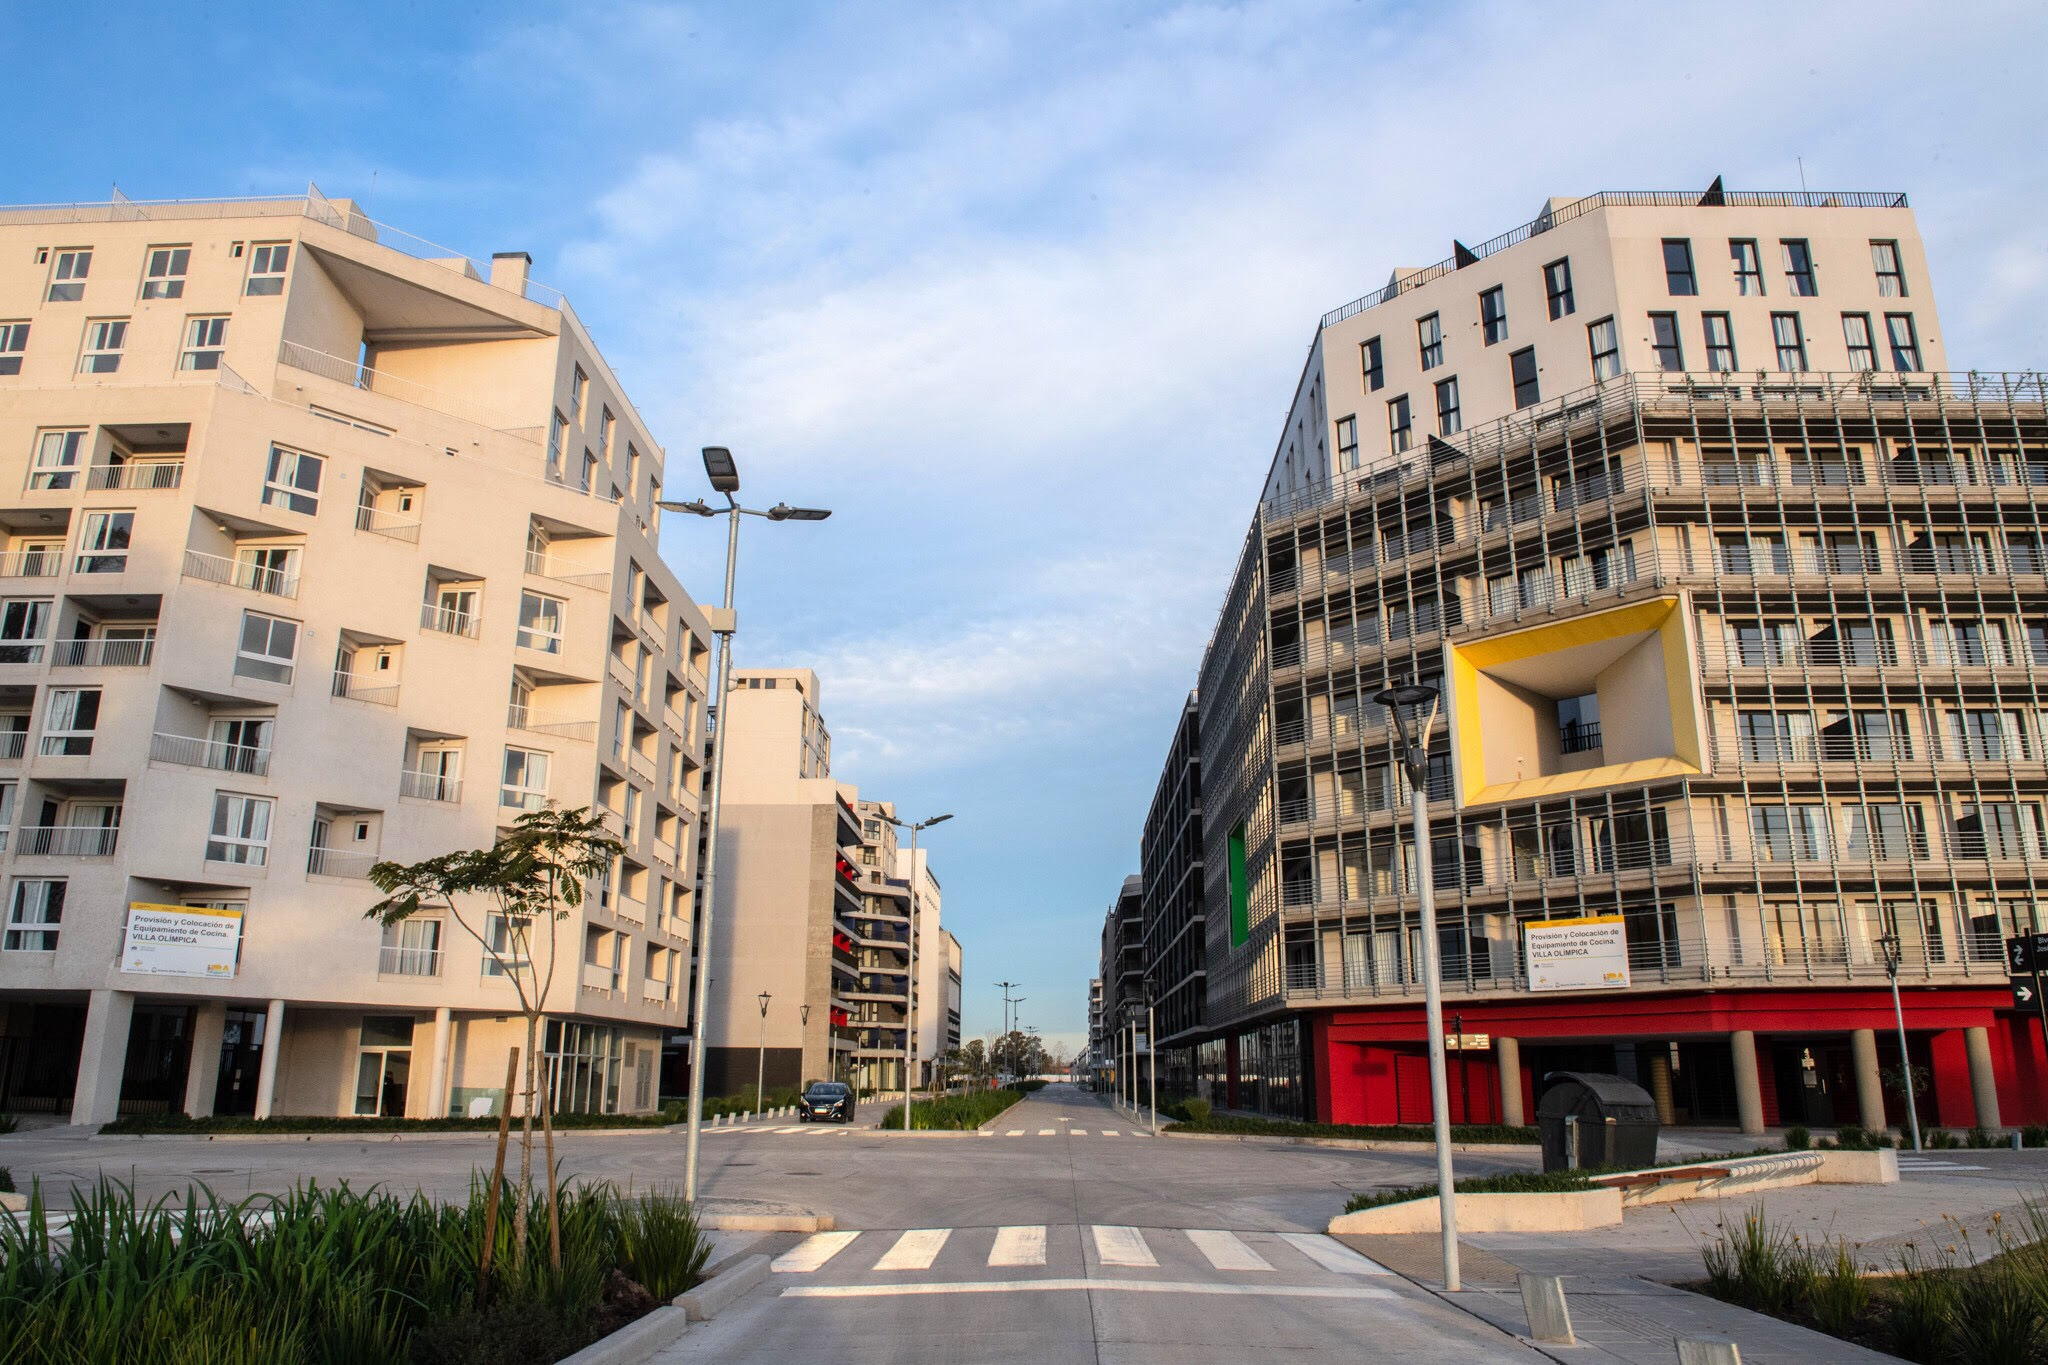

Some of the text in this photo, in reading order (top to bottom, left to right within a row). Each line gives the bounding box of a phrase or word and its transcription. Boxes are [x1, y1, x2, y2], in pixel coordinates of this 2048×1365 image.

[132, 933, 156, 941] VILLA
[133, 924, 188, 935] Equipamiento
[200, 929, 229, 938] Cocina.
[1531, 940, 1578, 950] Equipamiento
[1590, 938, 1616, 946] Cocina.
